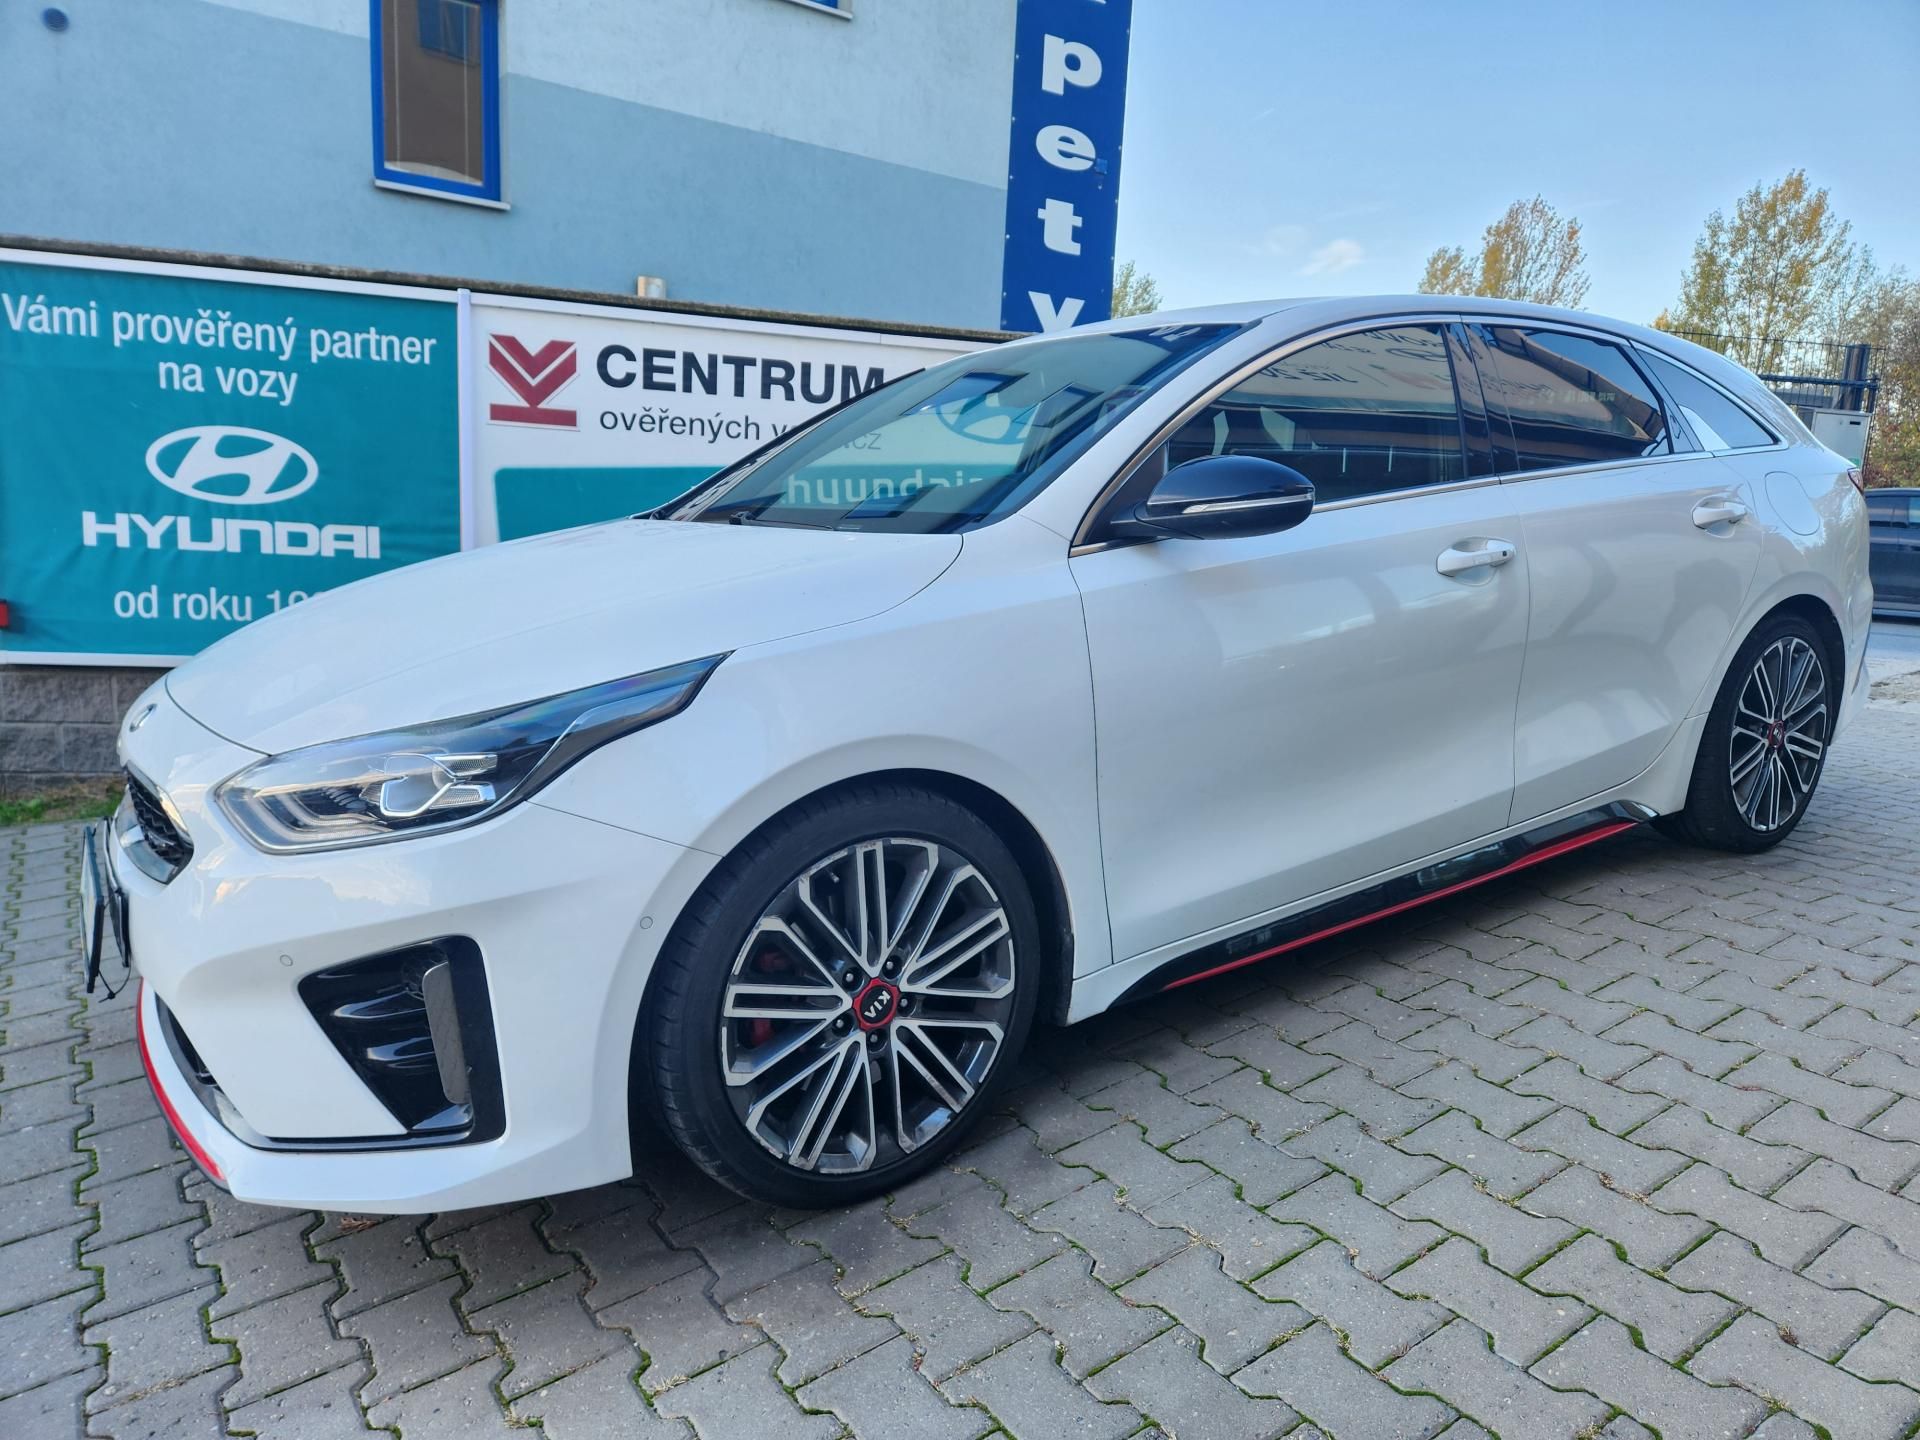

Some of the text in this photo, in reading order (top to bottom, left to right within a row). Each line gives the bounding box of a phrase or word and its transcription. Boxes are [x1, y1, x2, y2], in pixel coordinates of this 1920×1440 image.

[2, 293, 437, 364] Vámi prověřený partner
[159, 361, 298, 406] na vozy
[596, 344, 885, 405] CENTRUM
[599, 406, 760, 444] ověřených
[82, 511, 381, 559] HYUNDAI
[114, 584, 159, 619] od
[173, 587, 251, 621] roku
[864, 990, 891, 1018] KIA
